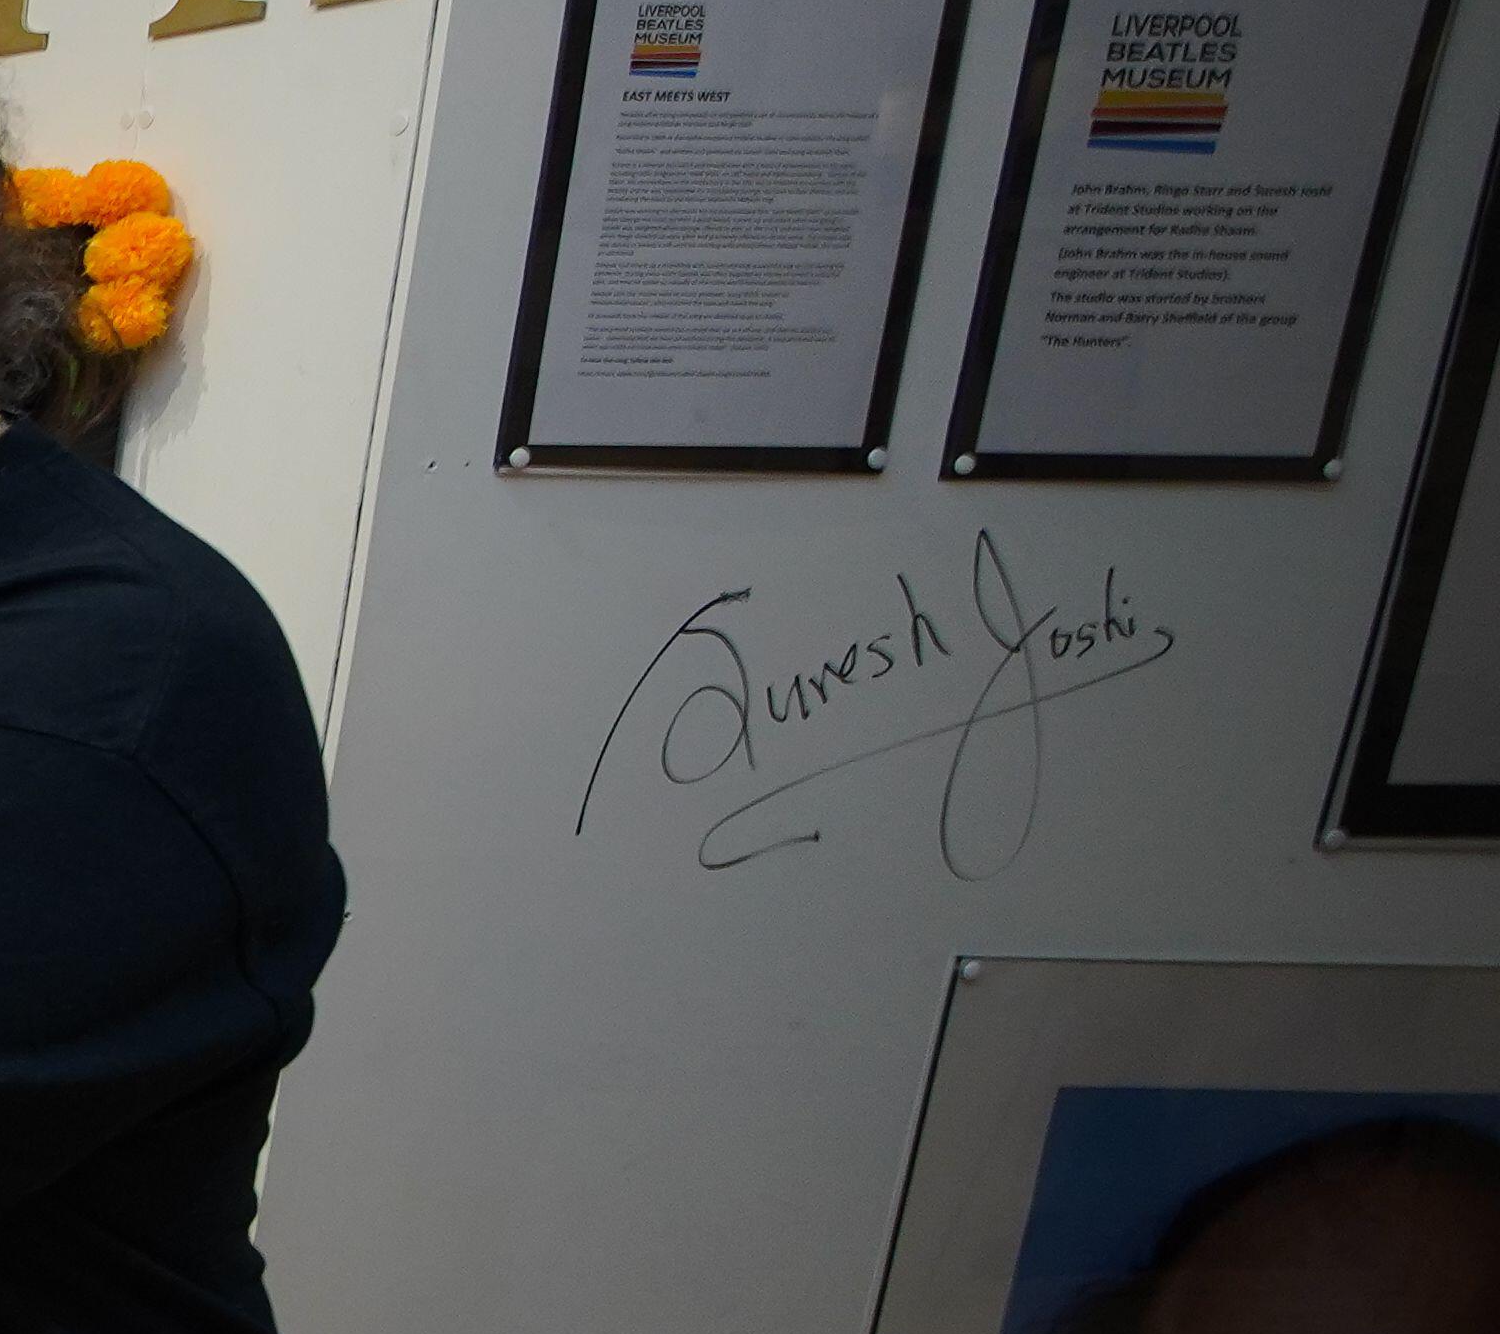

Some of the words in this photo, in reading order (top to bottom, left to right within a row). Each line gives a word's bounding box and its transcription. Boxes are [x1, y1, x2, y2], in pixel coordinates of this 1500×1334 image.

[638, 4, 706, 18] LIVERPOOL
[636, 19, 704, 31] BEATLES
[1111, 13, 1242, 38] LIVERPOOL
[634, 33, 703, 45] MUSEUM
[1106, 41, 1237, 63] BEATLES
[1100, 67, 1233, 89] MUSEUM
[622, 91, 653, 102] EAST
[654, 91, 695, 102] MEETS
[696, 91, 731, 102] WEST
[576, 571, 951, 835] Suresh
